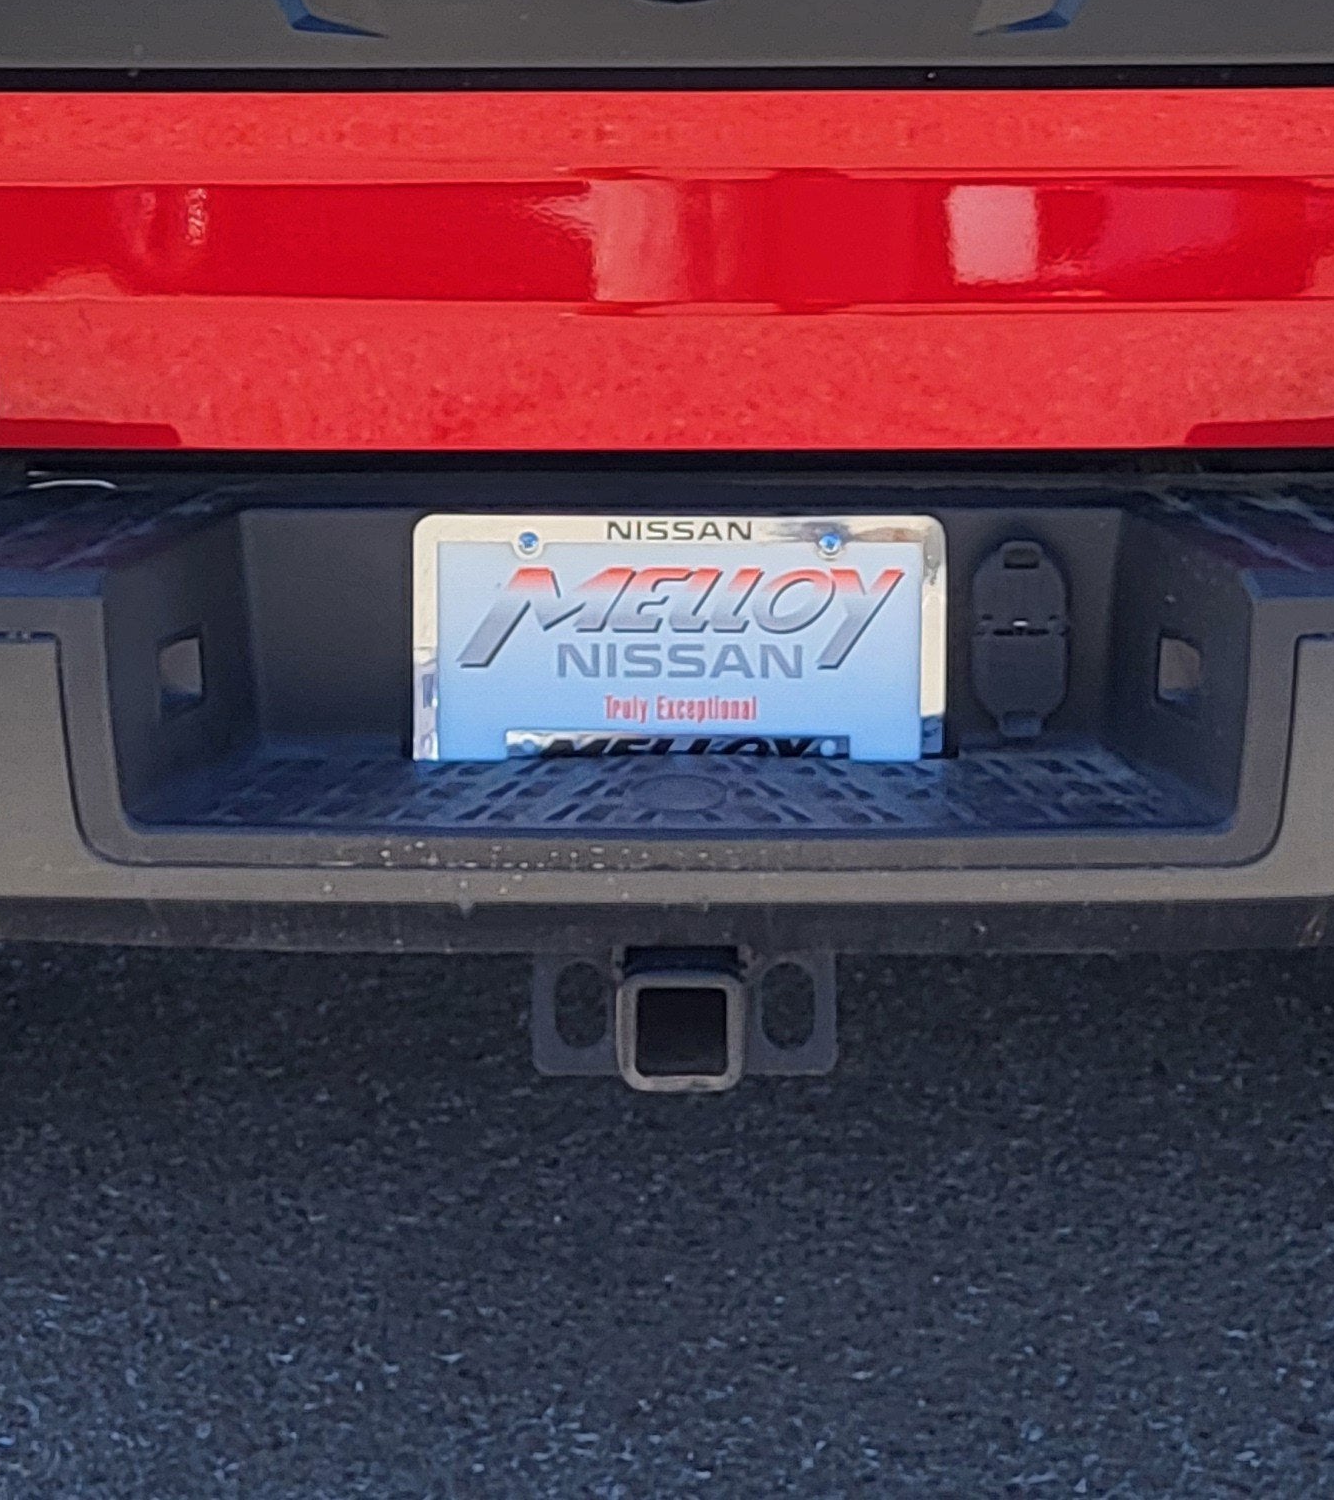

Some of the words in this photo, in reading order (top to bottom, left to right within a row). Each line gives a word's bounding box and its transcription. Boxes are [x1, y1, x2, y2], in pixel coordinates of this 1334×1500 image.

[606, 520, 753, 542] NISSAN
[456, 566, 905, 671] MELLOY
[556, 642, 804, 680] NISSAN
[604, 693, 648, 724] Truly
[656, 693, 757, 723] Exceptional
